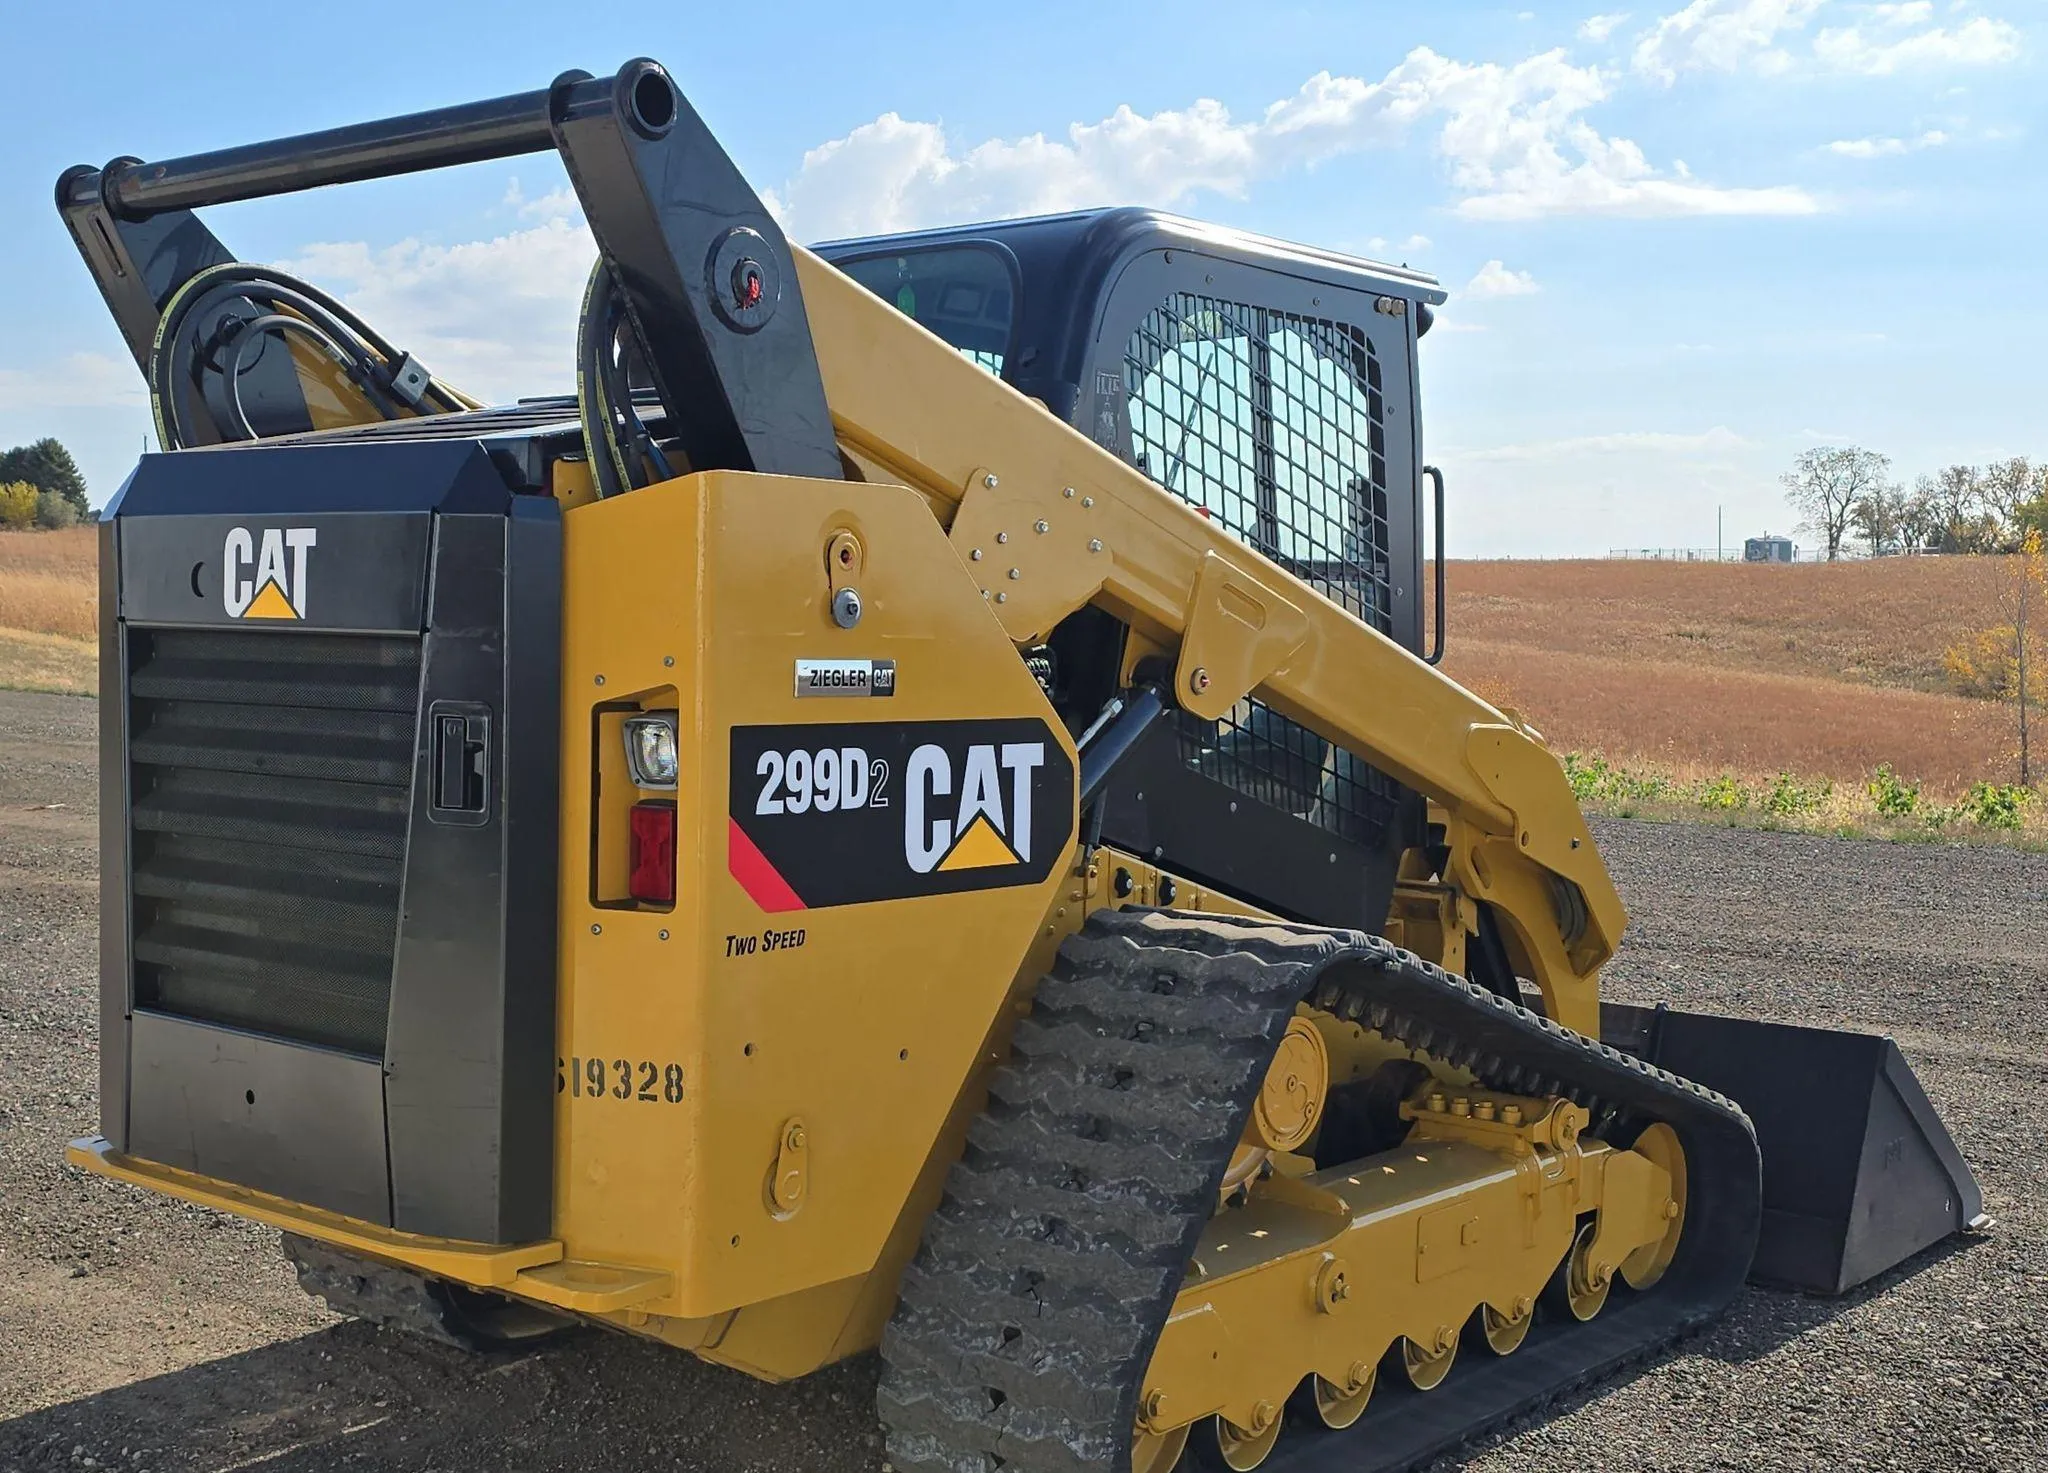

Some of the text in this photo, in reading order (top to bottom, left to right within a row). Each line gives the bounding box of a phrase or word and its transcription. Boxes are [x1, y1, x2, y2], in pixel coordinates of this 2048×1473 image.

[224, 527, 317, 620] CAT
[810, 668, 894, 687] ZIEGLER CAT
[755, 742, 1045, 873] 299D2 CAT
